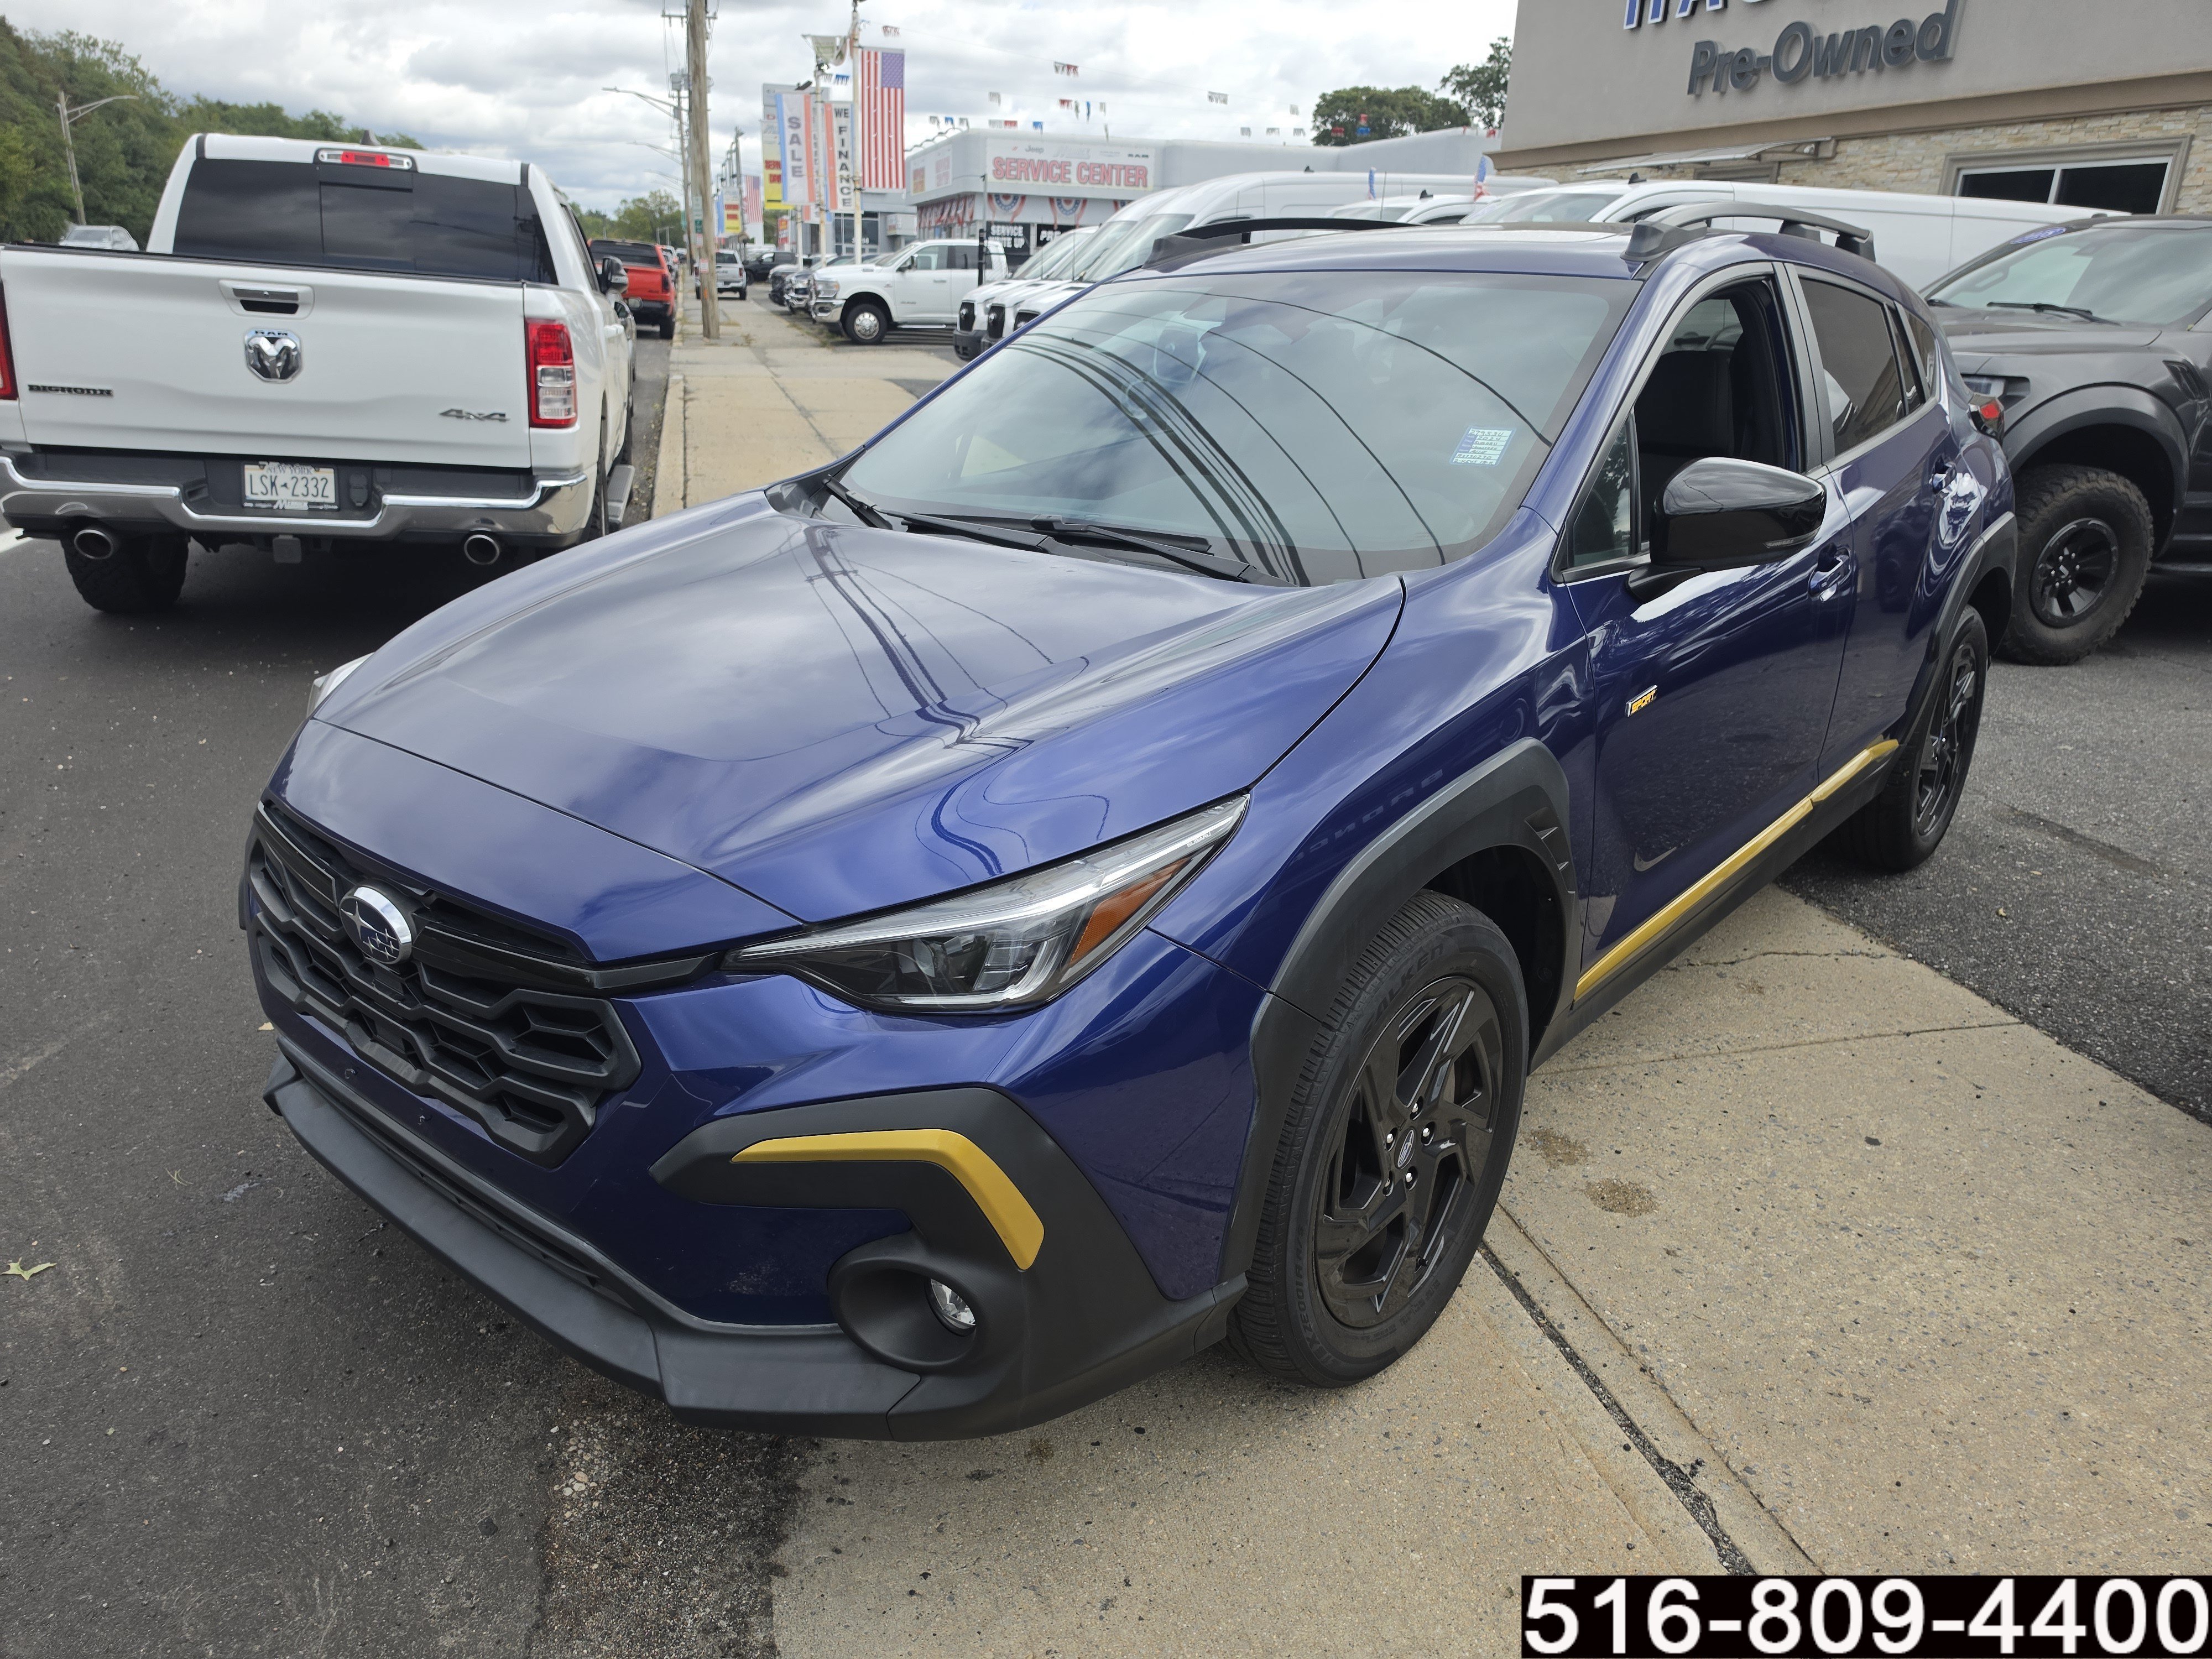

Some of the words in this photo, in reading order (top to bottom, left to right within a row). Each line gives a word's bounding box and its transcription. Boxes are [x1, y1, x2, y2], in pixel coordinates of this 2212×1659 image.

[1687, 0, 1958, 95] Pre-Owned
[834, 108, 849, 118] WE
[788, 117, 803, 178] SALE
[1025, 145, 1044, 154] Jeep
[838, 126, 852, 207] FINANCE
[993, 156, 1071, 183] SERVICE
[1077, 161, 1148, 187] CENTER
[990, 225, 1023, 237] SERVICE
[1014, 237, 1025, 248] UP
[268, 464, 286, 473] NEW
[288, 465, 312, 474] YORK
[1631, 688, 1658, 714] SPORT
[1187, 832, 1211, 847] SUBARU
